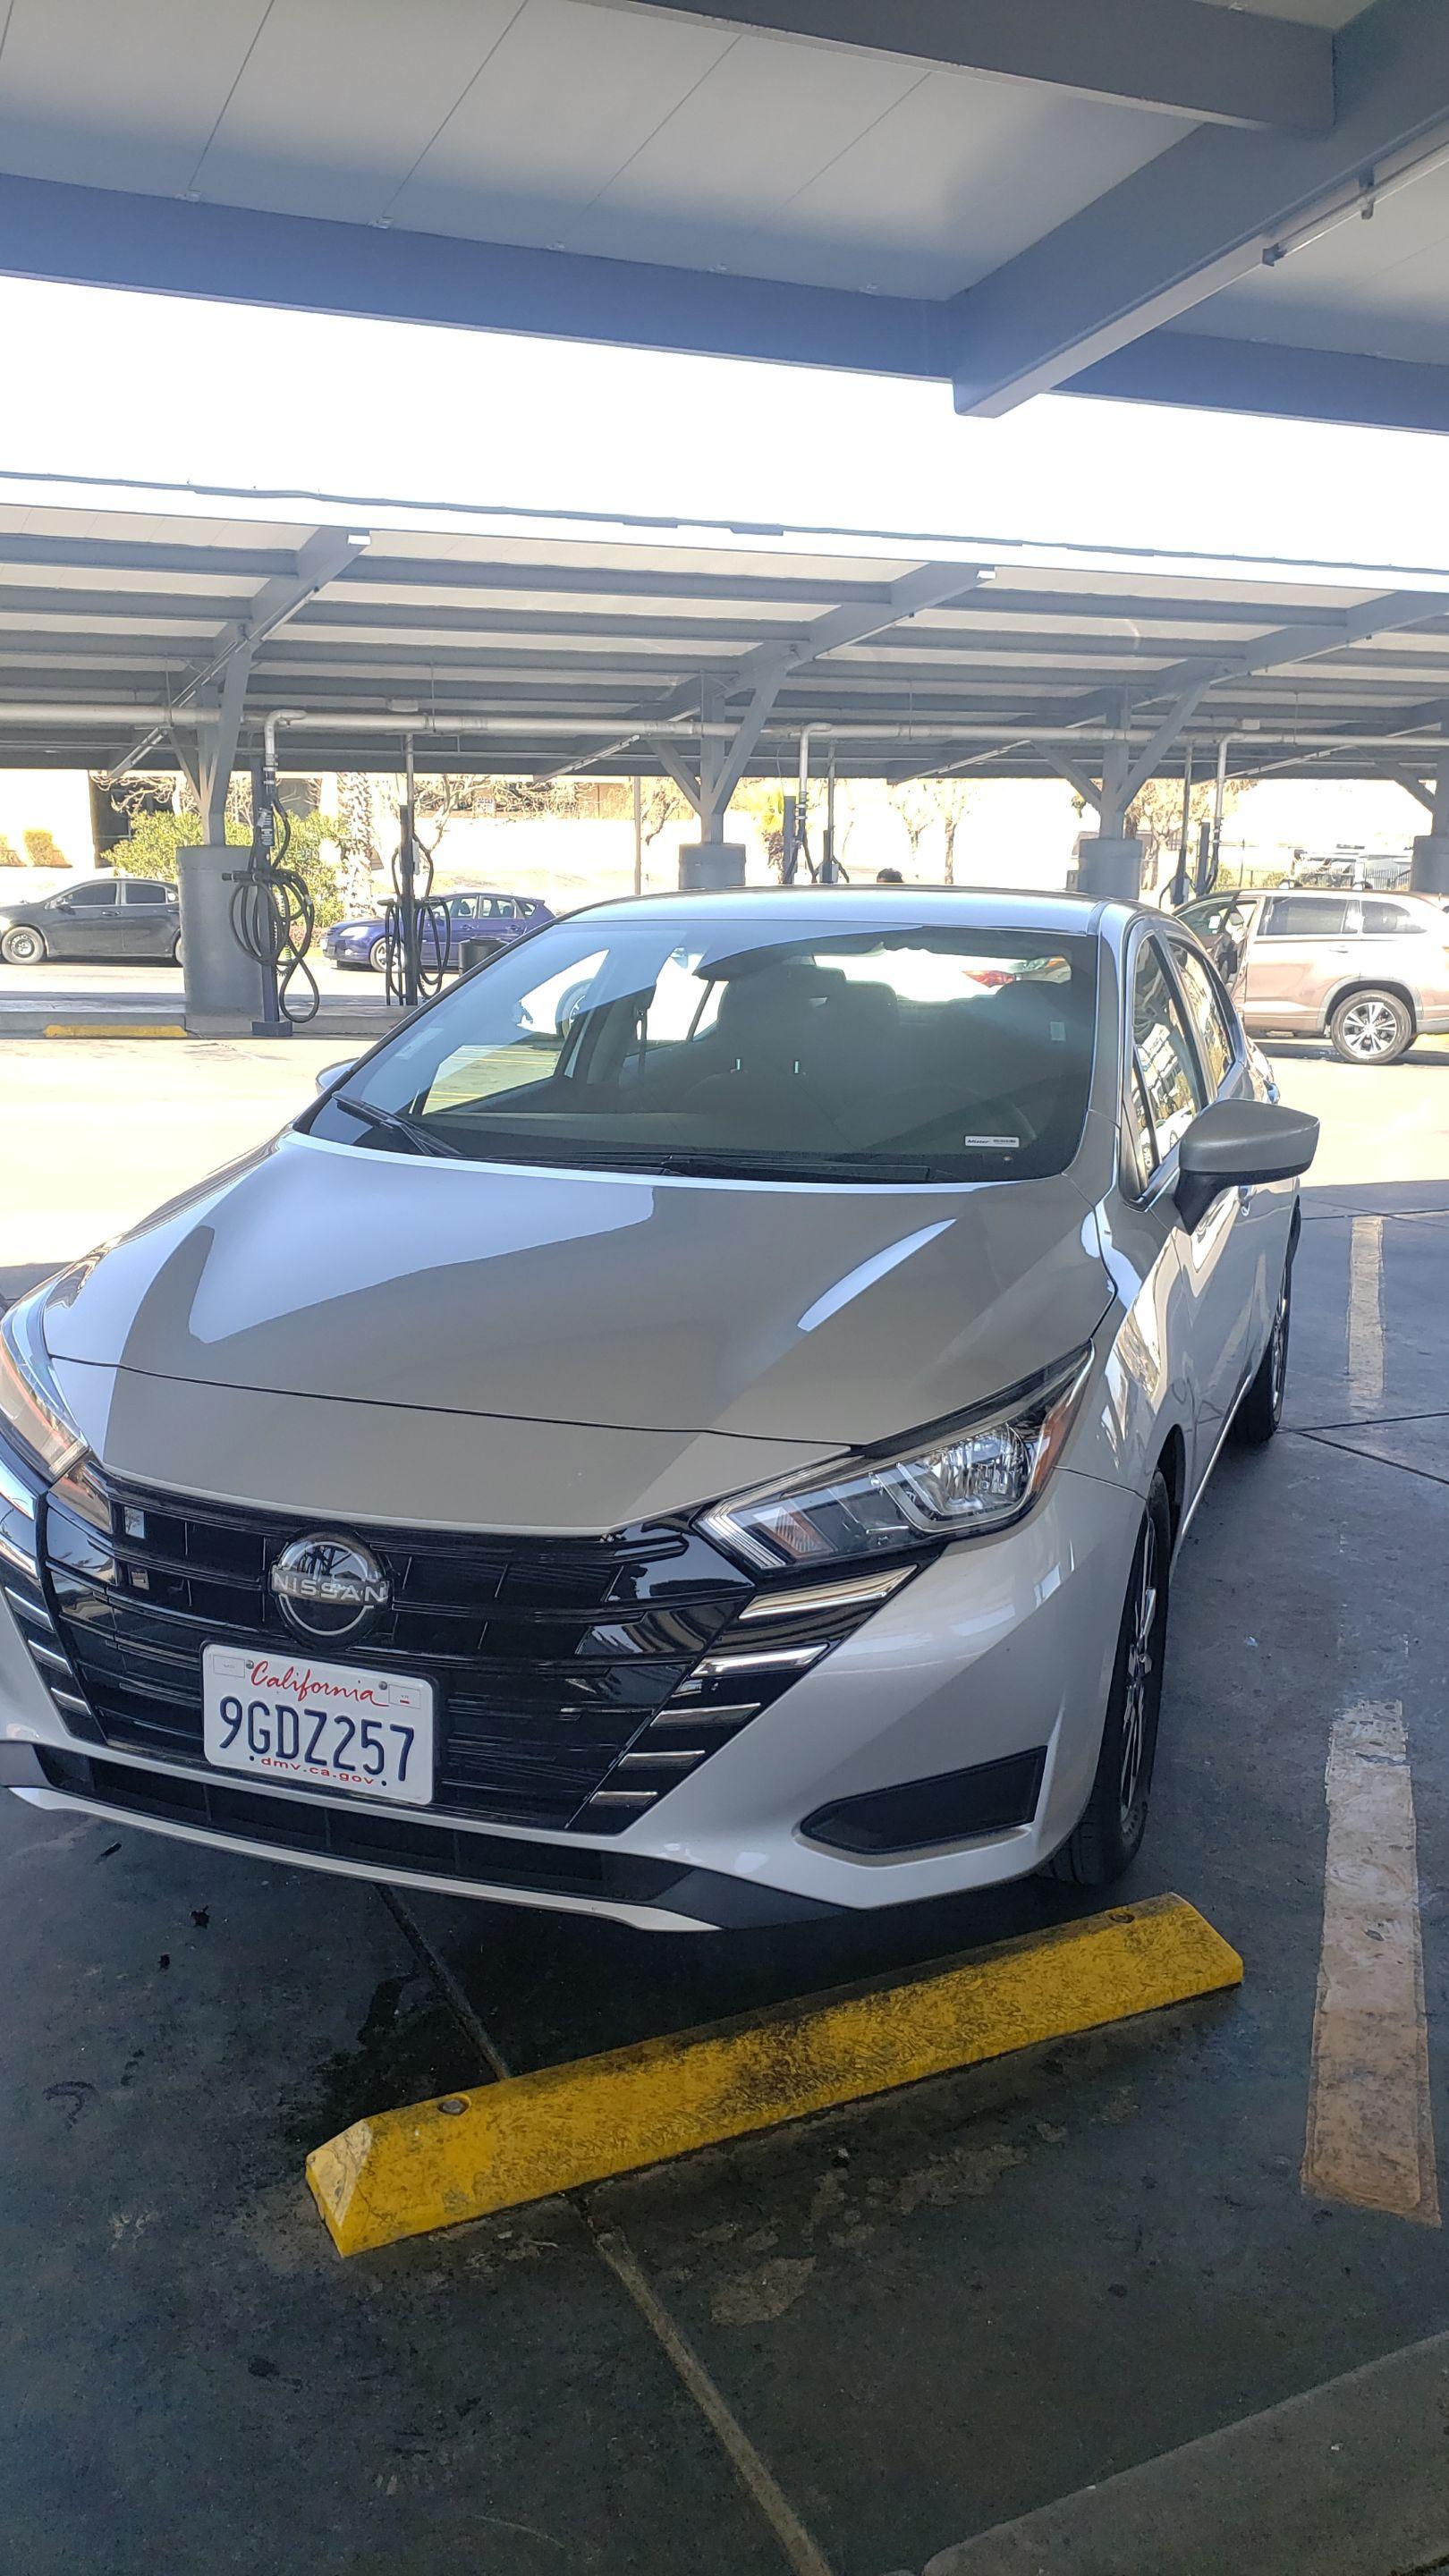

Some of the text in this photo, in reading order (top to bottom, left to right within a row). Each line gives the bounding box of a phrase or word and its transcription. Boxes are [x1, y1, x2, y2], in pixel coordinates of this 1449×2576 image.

[273, 1572, 385, 1602] NISSAN
[250, 1660, 390, 1707] California
[219, 1695, 415, 1782] 9GDZ257
[261, 1757, 374, 1785] dmv.ca.gov
